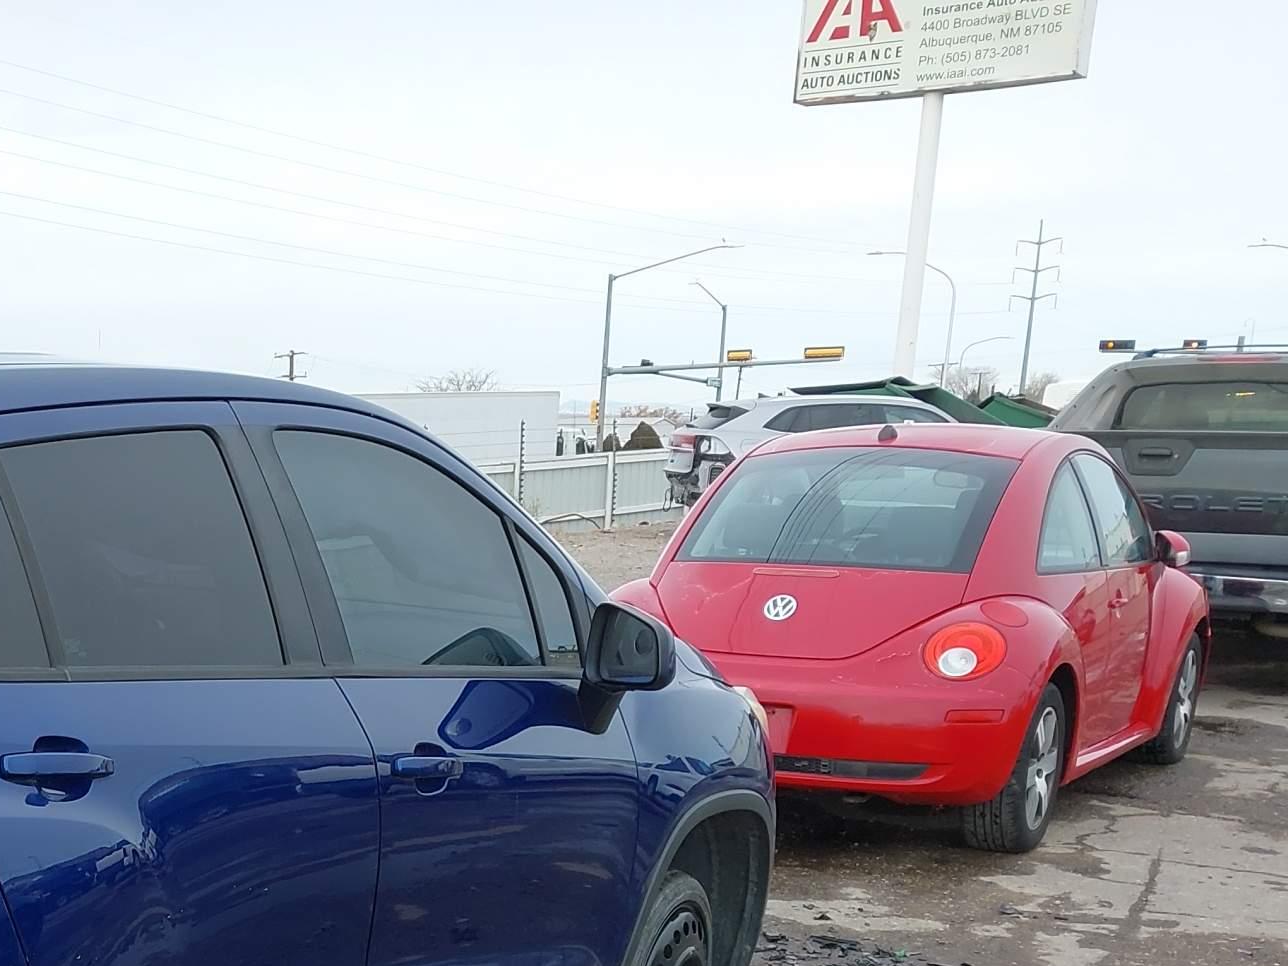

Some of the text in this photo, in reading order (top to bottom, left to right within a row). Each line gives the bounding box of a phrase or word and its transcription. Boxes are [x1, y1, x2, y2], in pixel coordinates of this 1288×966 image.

[920, 3, 1072, 31] 4400 Broadway BLVD SE
[922, 1, 984, 17] Insurance
[1000, 26, 1021, 39] NM
[1024, 21, 1063, 37] 87105
[803, 45, 903, 69] INSURANCE
[918, 44, 1031, 66] Ph: (505) 873-2081
[800, 67, 901, 90] AUTO AUCTIONS
[915, 66, 995, 82] www.iaai.com
